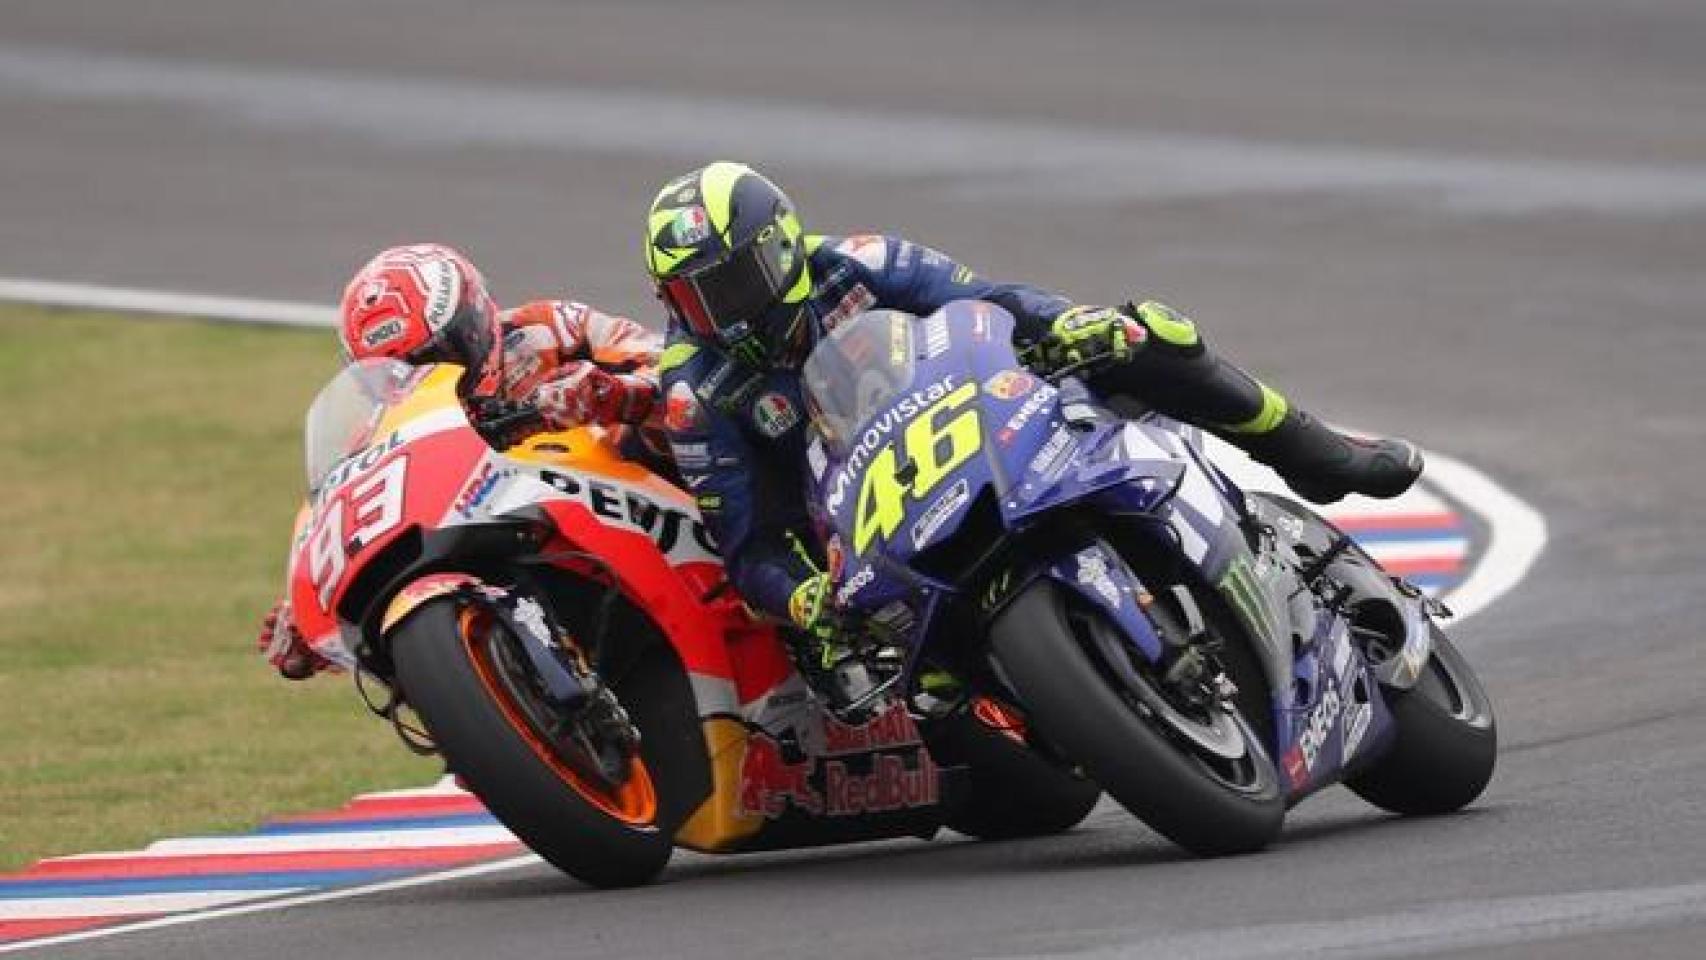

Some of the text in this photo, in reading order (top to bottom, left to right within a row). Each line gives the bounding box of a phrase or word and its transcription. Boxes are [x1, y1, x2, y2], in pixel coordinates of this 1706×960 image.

[847, 374, 952, 481] movistar
[854, 381, 978, 557] 46
[312, 453, 408, 613] 93
